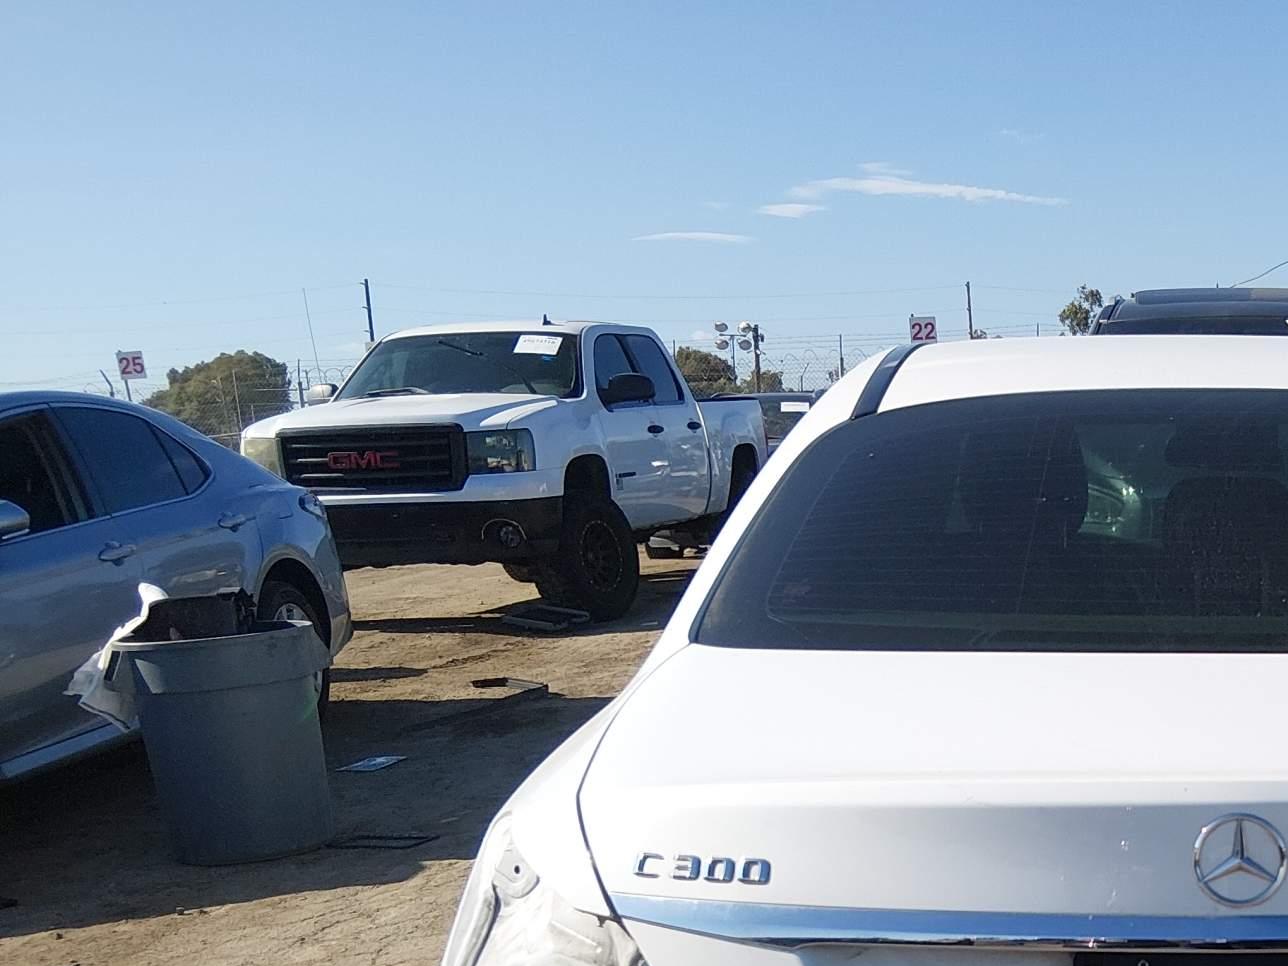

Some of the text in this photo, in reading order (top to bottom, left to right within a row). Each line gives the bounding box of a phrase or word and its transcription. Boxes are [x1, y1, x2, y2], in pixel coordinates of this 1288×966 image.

[912, 322, 937, 341] 22
[119, 356, 144, 375] 25
[328, 451, 400, 469] GMC
[634, 852, 772, 886] C 300
